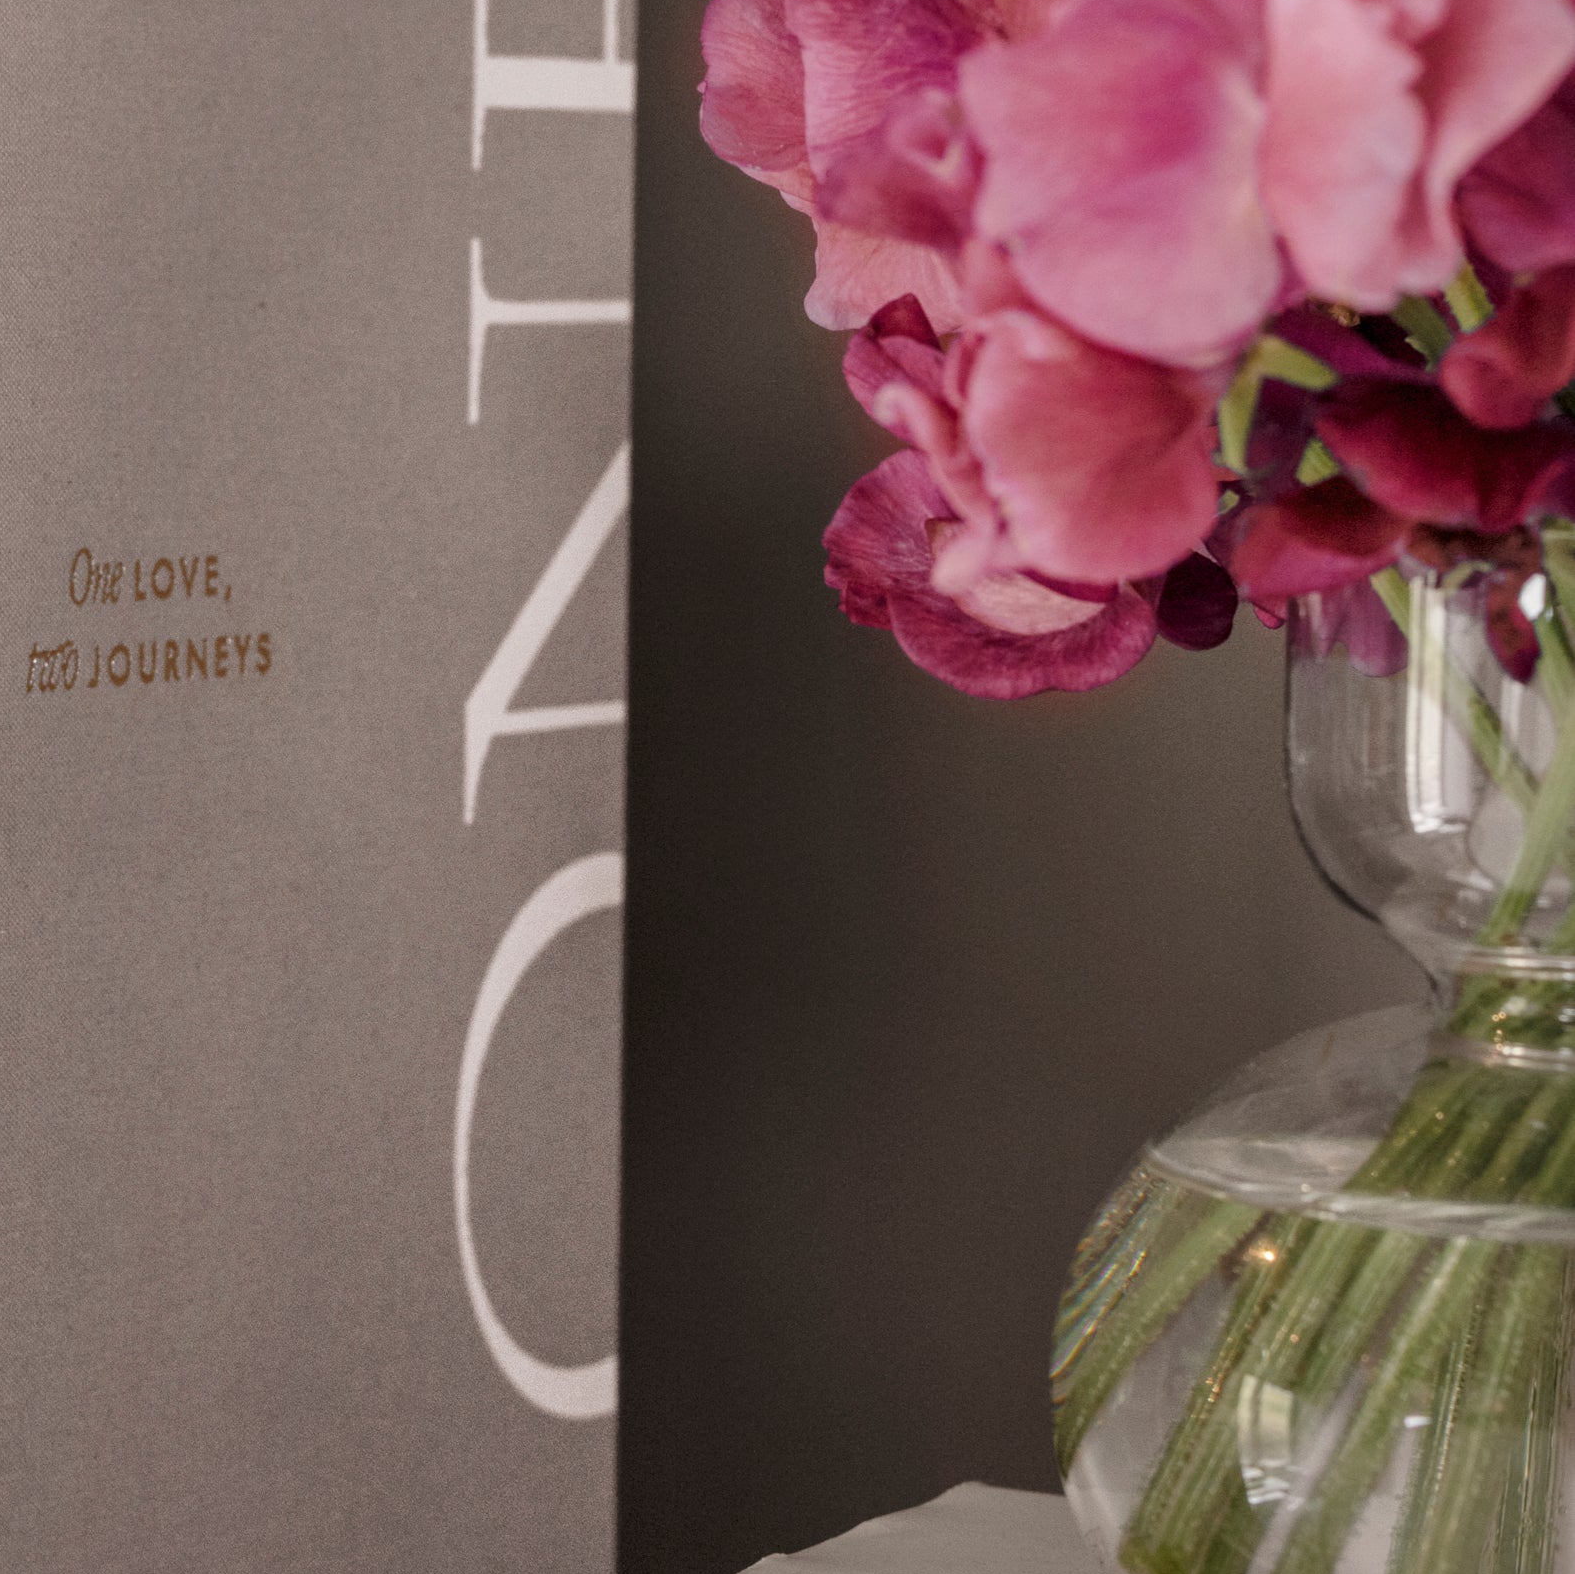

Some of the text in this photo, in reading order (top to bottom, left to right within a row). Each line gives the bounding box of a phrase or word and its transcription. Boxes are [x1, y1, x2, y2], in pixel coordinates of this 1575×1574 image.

[69, 546, 232, 607] One LOVE,
[86, 631, 272, 689] JOURNEYS
